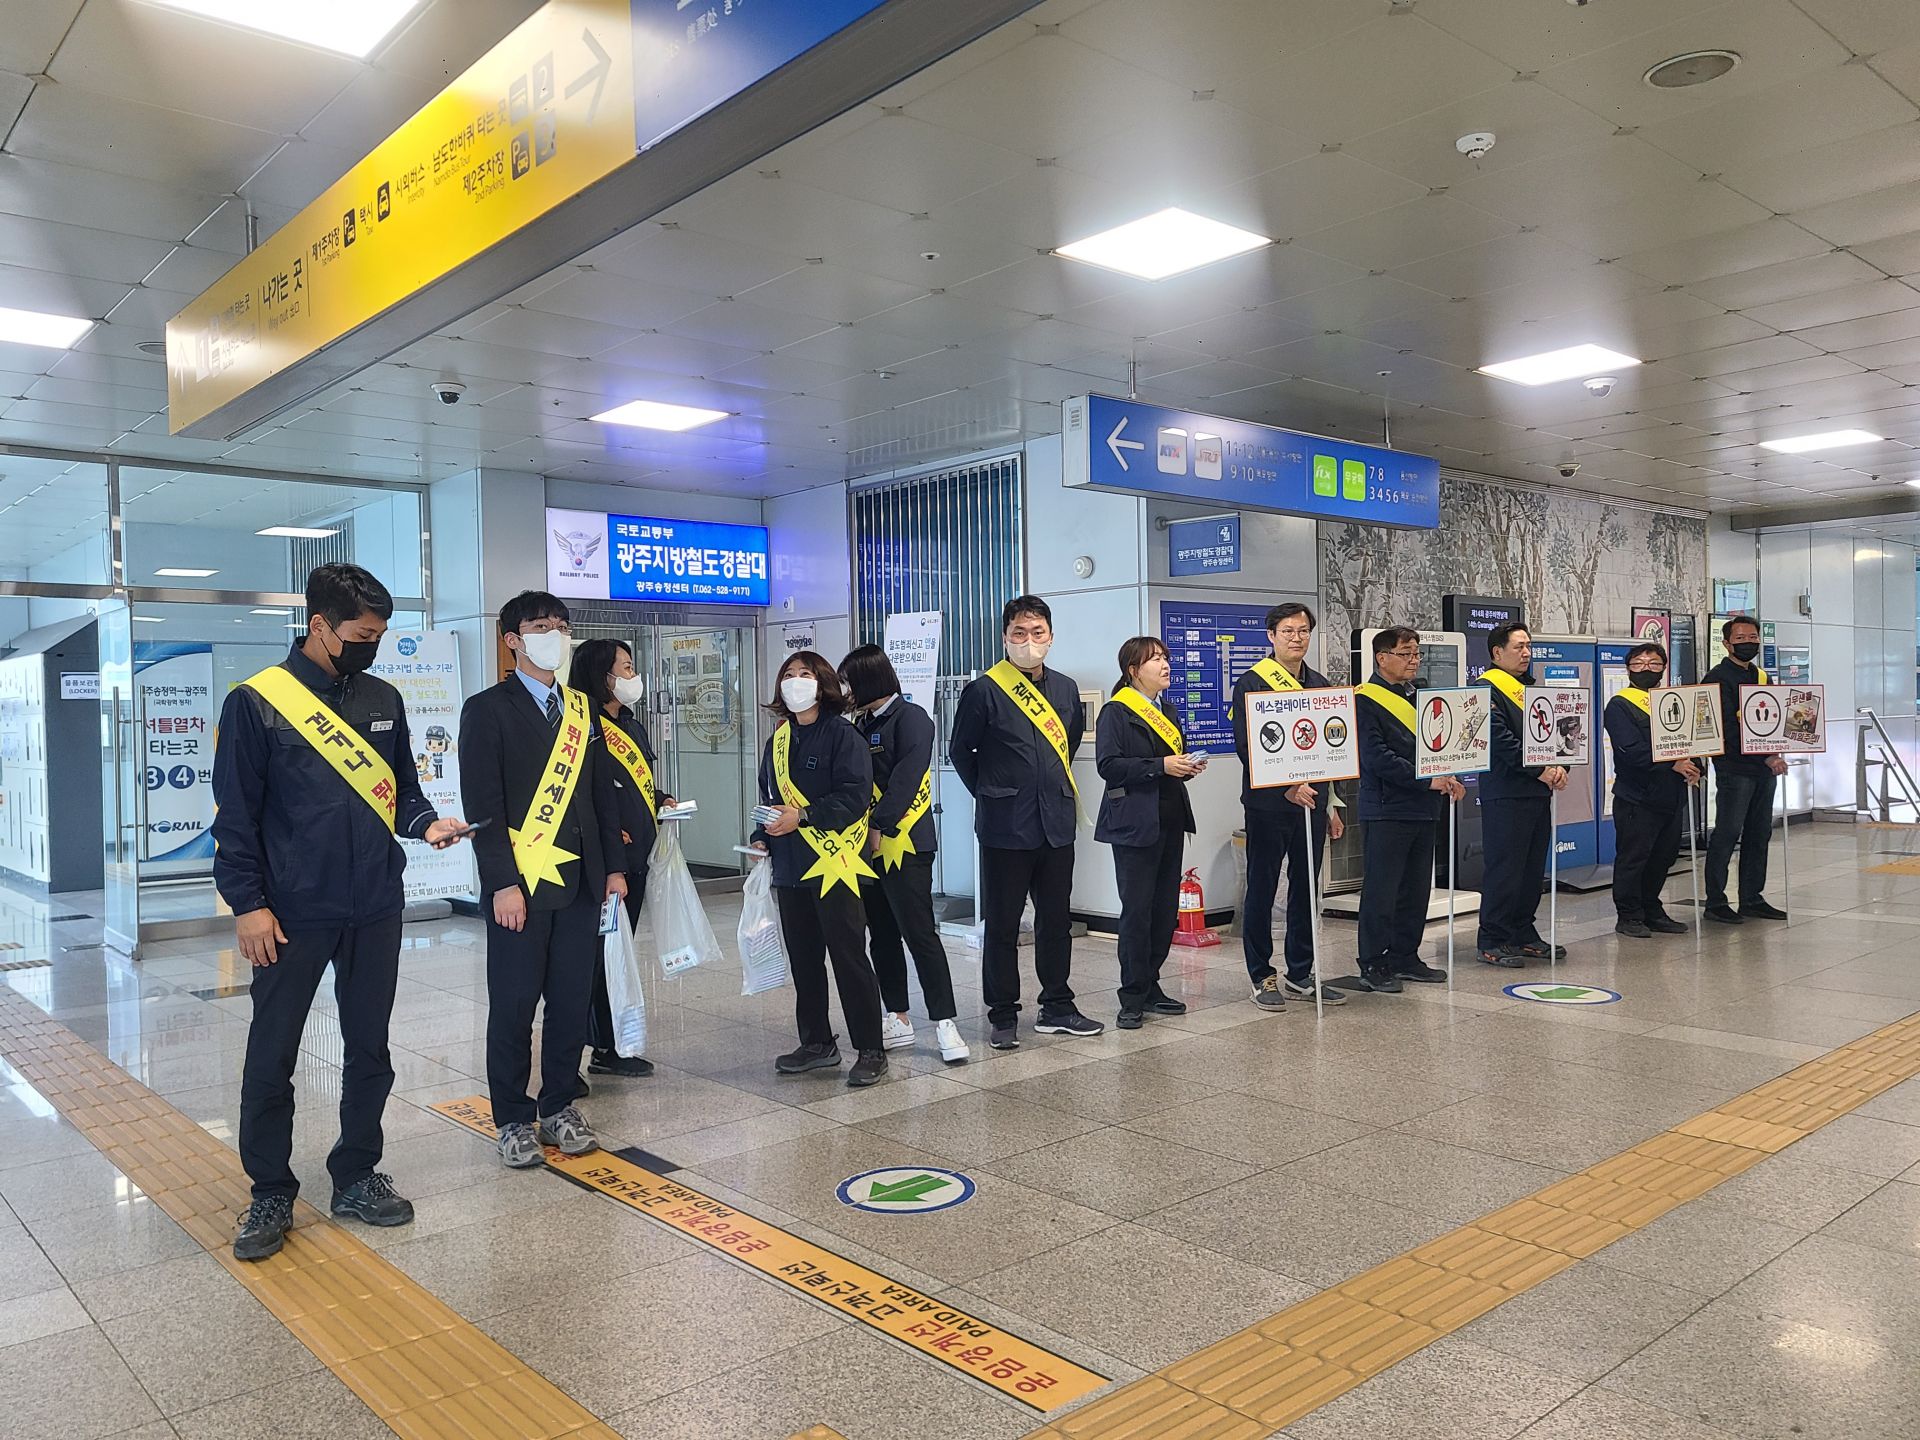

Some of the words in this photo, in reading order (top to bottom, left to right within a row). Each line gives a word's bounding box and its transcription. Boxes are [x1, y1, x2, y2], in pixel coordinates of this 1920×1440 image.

[395, 163, 425, 198] 시외버스
[433, 123, 475, 173] 남도한바퀴
[477, 112, 494, 136] 타는
[463, 150, 504, 196] 제2주차장
[486, 177, 505, 197] Parking
[360, 201, 373, 226] 택시
[312, 226, 340, 261] 제1주차장
[262, 272, 289, 310] 나가는
[293, 257, 302, 292] 곳
[289, 301, 300, 319] 出口
[1345, 471, 1364, 485] 무궁화
[1369, 466, 1375, 480] 7
[1378, 467, 1384, 481] 8
[1369, 486, 1375, 500] 3
[1377, 488, 1383, 501] 4
[1386, 489, 1391, 502] 5
[1393, 490, 1399, 503] 6
[617, 523, 674, 540] 국토교통부
[617, 543, 766, 580] 광주지방철도경찰대
[1178, 545, 1234, 560] 광주지방철도경찰대
[1202, 557, 1234, 567] 광주송정센터
[636, 580, 690, 594] 광주송정센터
[889, 639, 923, 650] 철도범죄신고
[415, 664, 433, 673] 준수
[436, 664, 453, 673] 기관
[145, 686, 177, 697] 주송정역
[184, 686, 208, 697] 광주역
[410, 678, 441, 688] 대한민국
[567, 687, 585, 721] 거나
[1012, 681, 1048, 717] 걷거나
[1043, 717, 1065, 743] 뛰지
[1255, 697, 1311, 714] 에스컬레이터
[1312, 694, 1348, 711] 안전수칙
[151, 739, 199, 756] 타는곳
[304, 711, 374, 772] 걷거나
[561, 723, 582, 765] 뛰지
[175, 767, 190, 785] 4
[198, 769, 212, 784] 번
[634, 764, 646, 779] 꼭
[657, 1182, 693, 1201] AREA
[583, 1166, 671, 1208] 고객신뢰선
[665, 1206, 772, 1254] 운임경계선
[690, 1198, 735, 1219] PAID
[879, 1284, 935, 1314] AREA
[779, 1260, 905, 1321] 고객신뢰선
[903, 1319, 1058, 1393] 운임경계선
[933, 1310, 991, 1338] PAID
